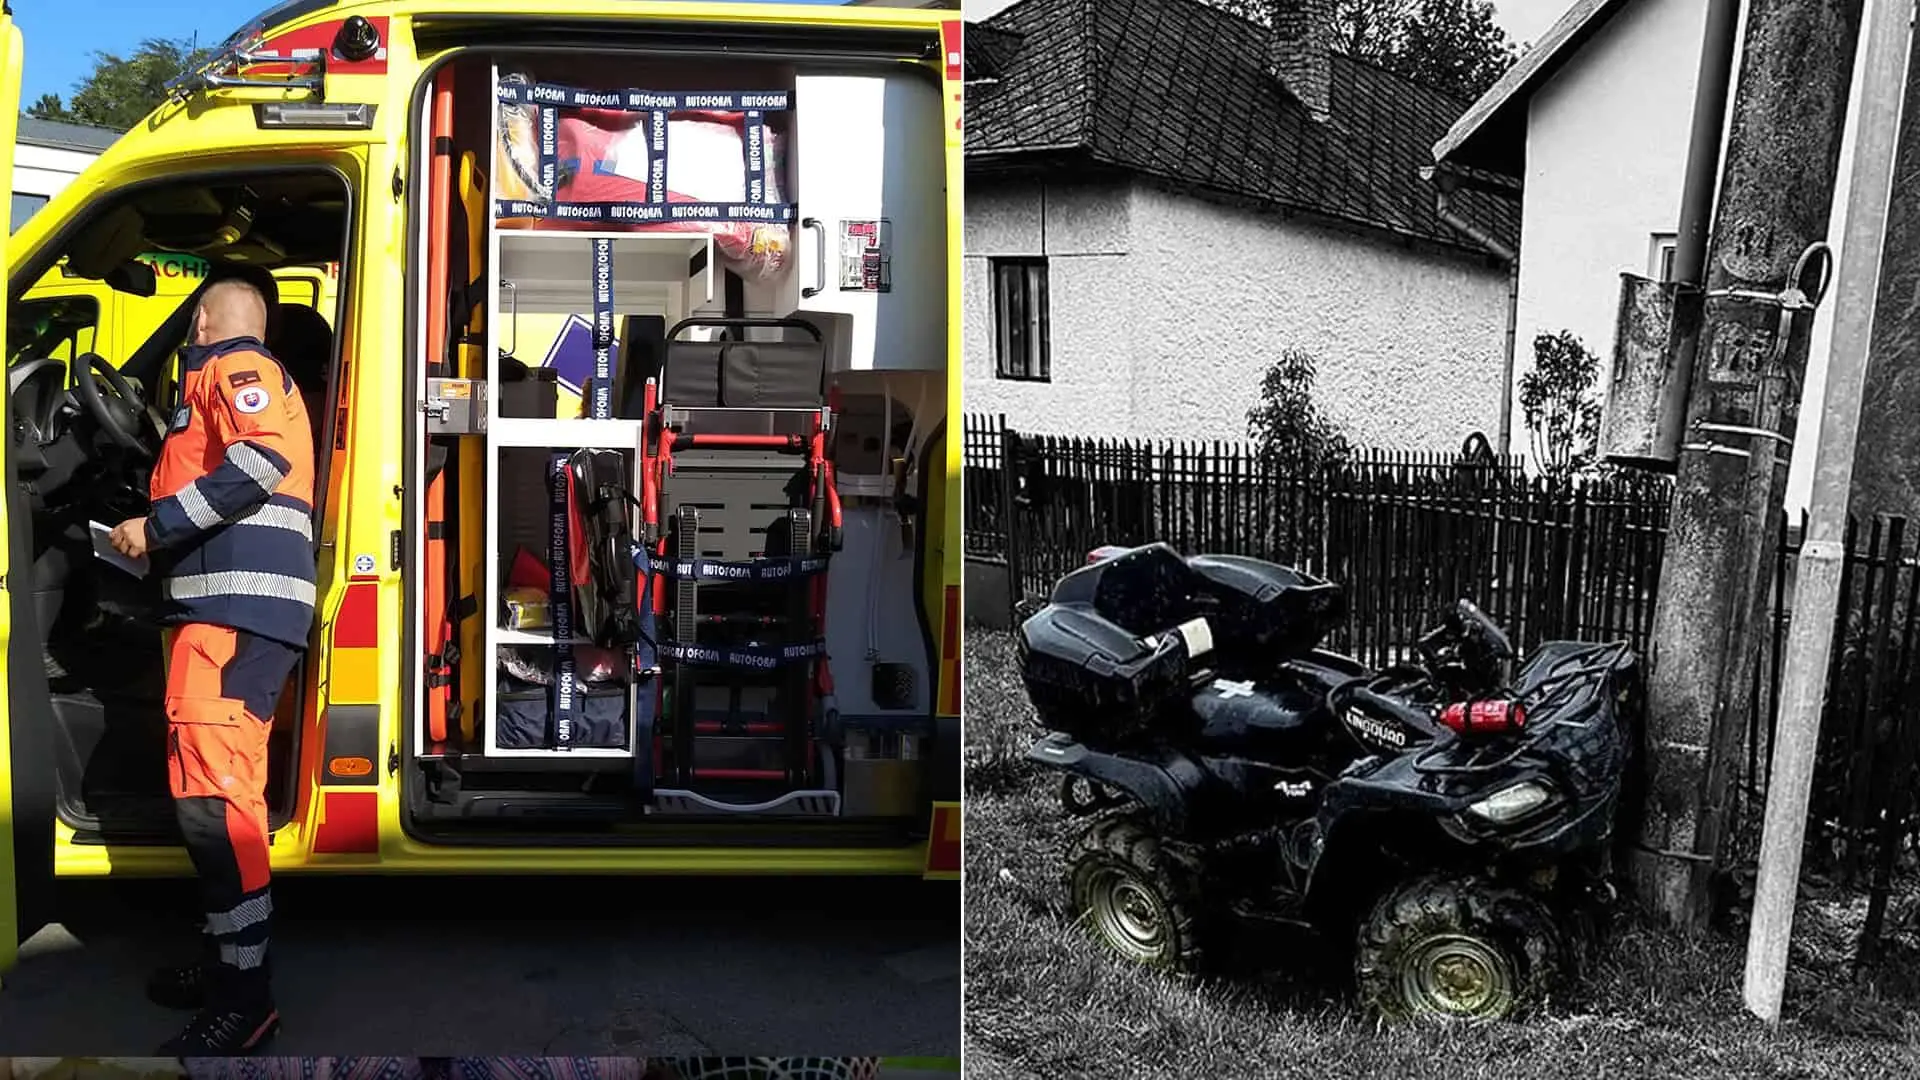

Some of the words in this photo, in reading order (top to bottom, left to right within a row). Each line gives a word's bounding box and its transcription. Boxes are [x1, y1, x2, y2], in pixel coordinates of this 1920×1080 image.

[574, 92, 620, 105] AUTOFORM
[685, 95, 732, 107] AUTOFORM
[741, 95, 787, 107] AUTOFORM
[543, 107, 554, 155] AUTOFORM
[749, 126, 761, 171] AUTOFORM
[556, 205, 602, 218] AUTOFORM
[671, 206, 719, 218] AUTOFORM
[728, 206, 774, 219] AUTOFORM
[702, 564, 751, 578] AUTOFORM
[729, 652, 777, 669] AUTOFORM
